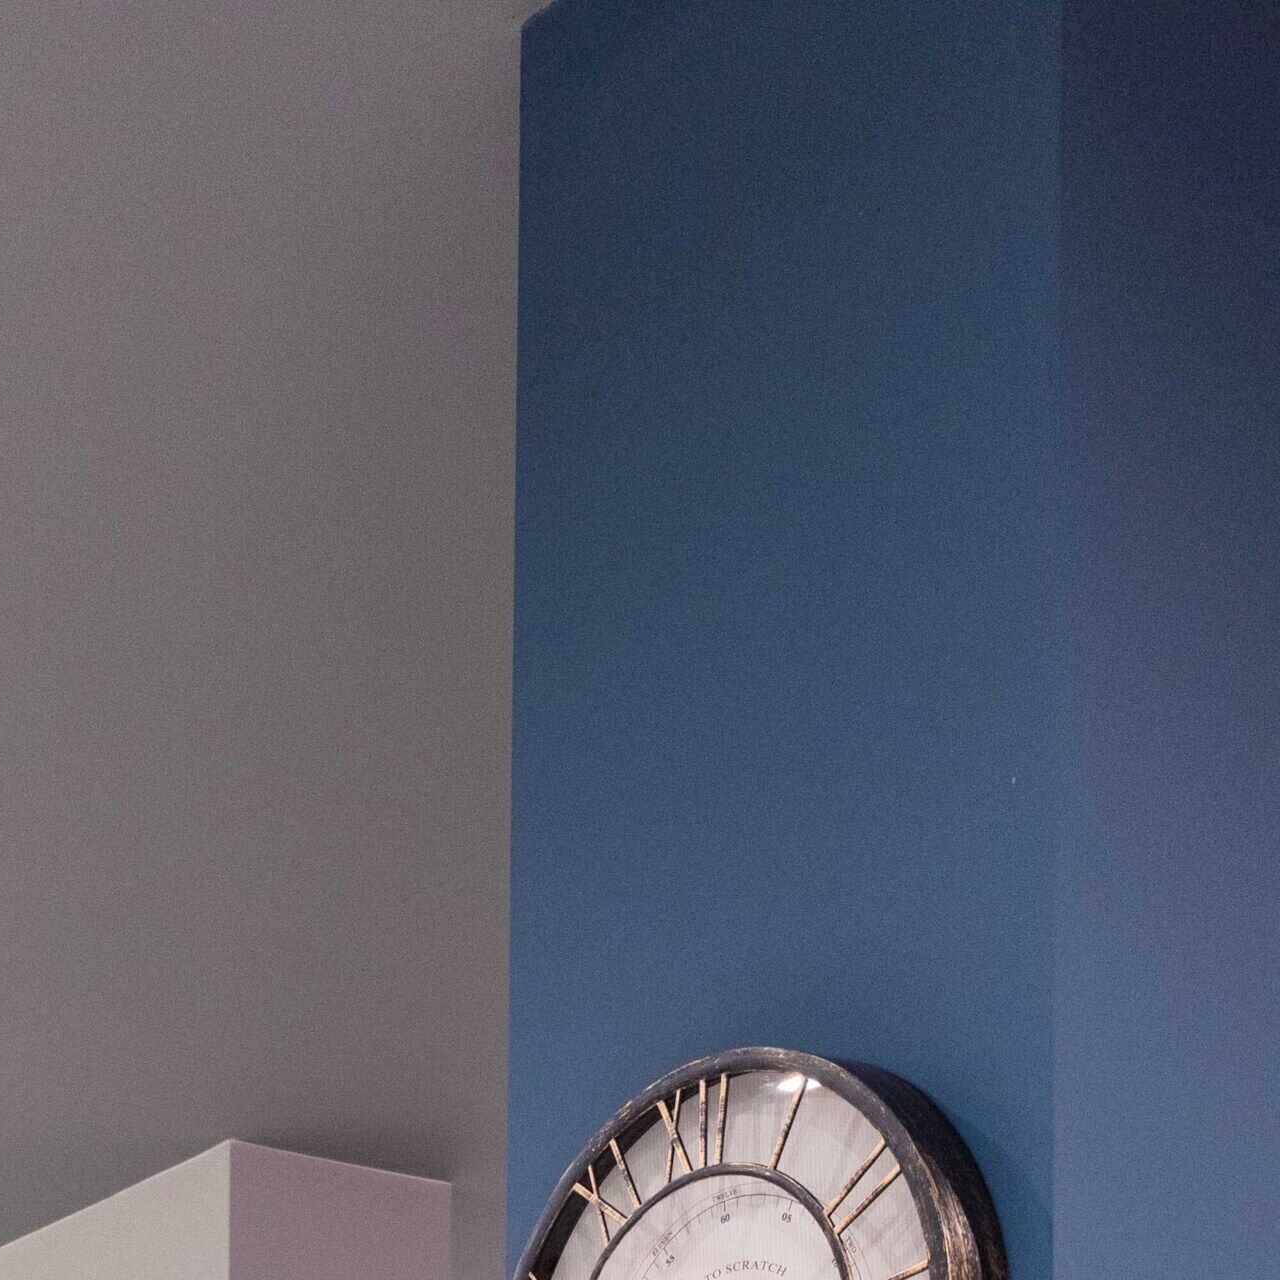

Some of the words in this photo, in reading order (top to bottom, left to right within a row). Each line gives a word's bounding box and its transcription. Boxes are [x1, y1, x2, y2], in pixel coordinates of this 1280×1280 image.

[720, 1213, 731, 1224] 60
[781, 1213, 792, 1224] 05
[845, 1236, 857, 1254] TWO
[665, 1254, 675, 1268] 55
[725, 1260, 788, 1277] SCRATCH
